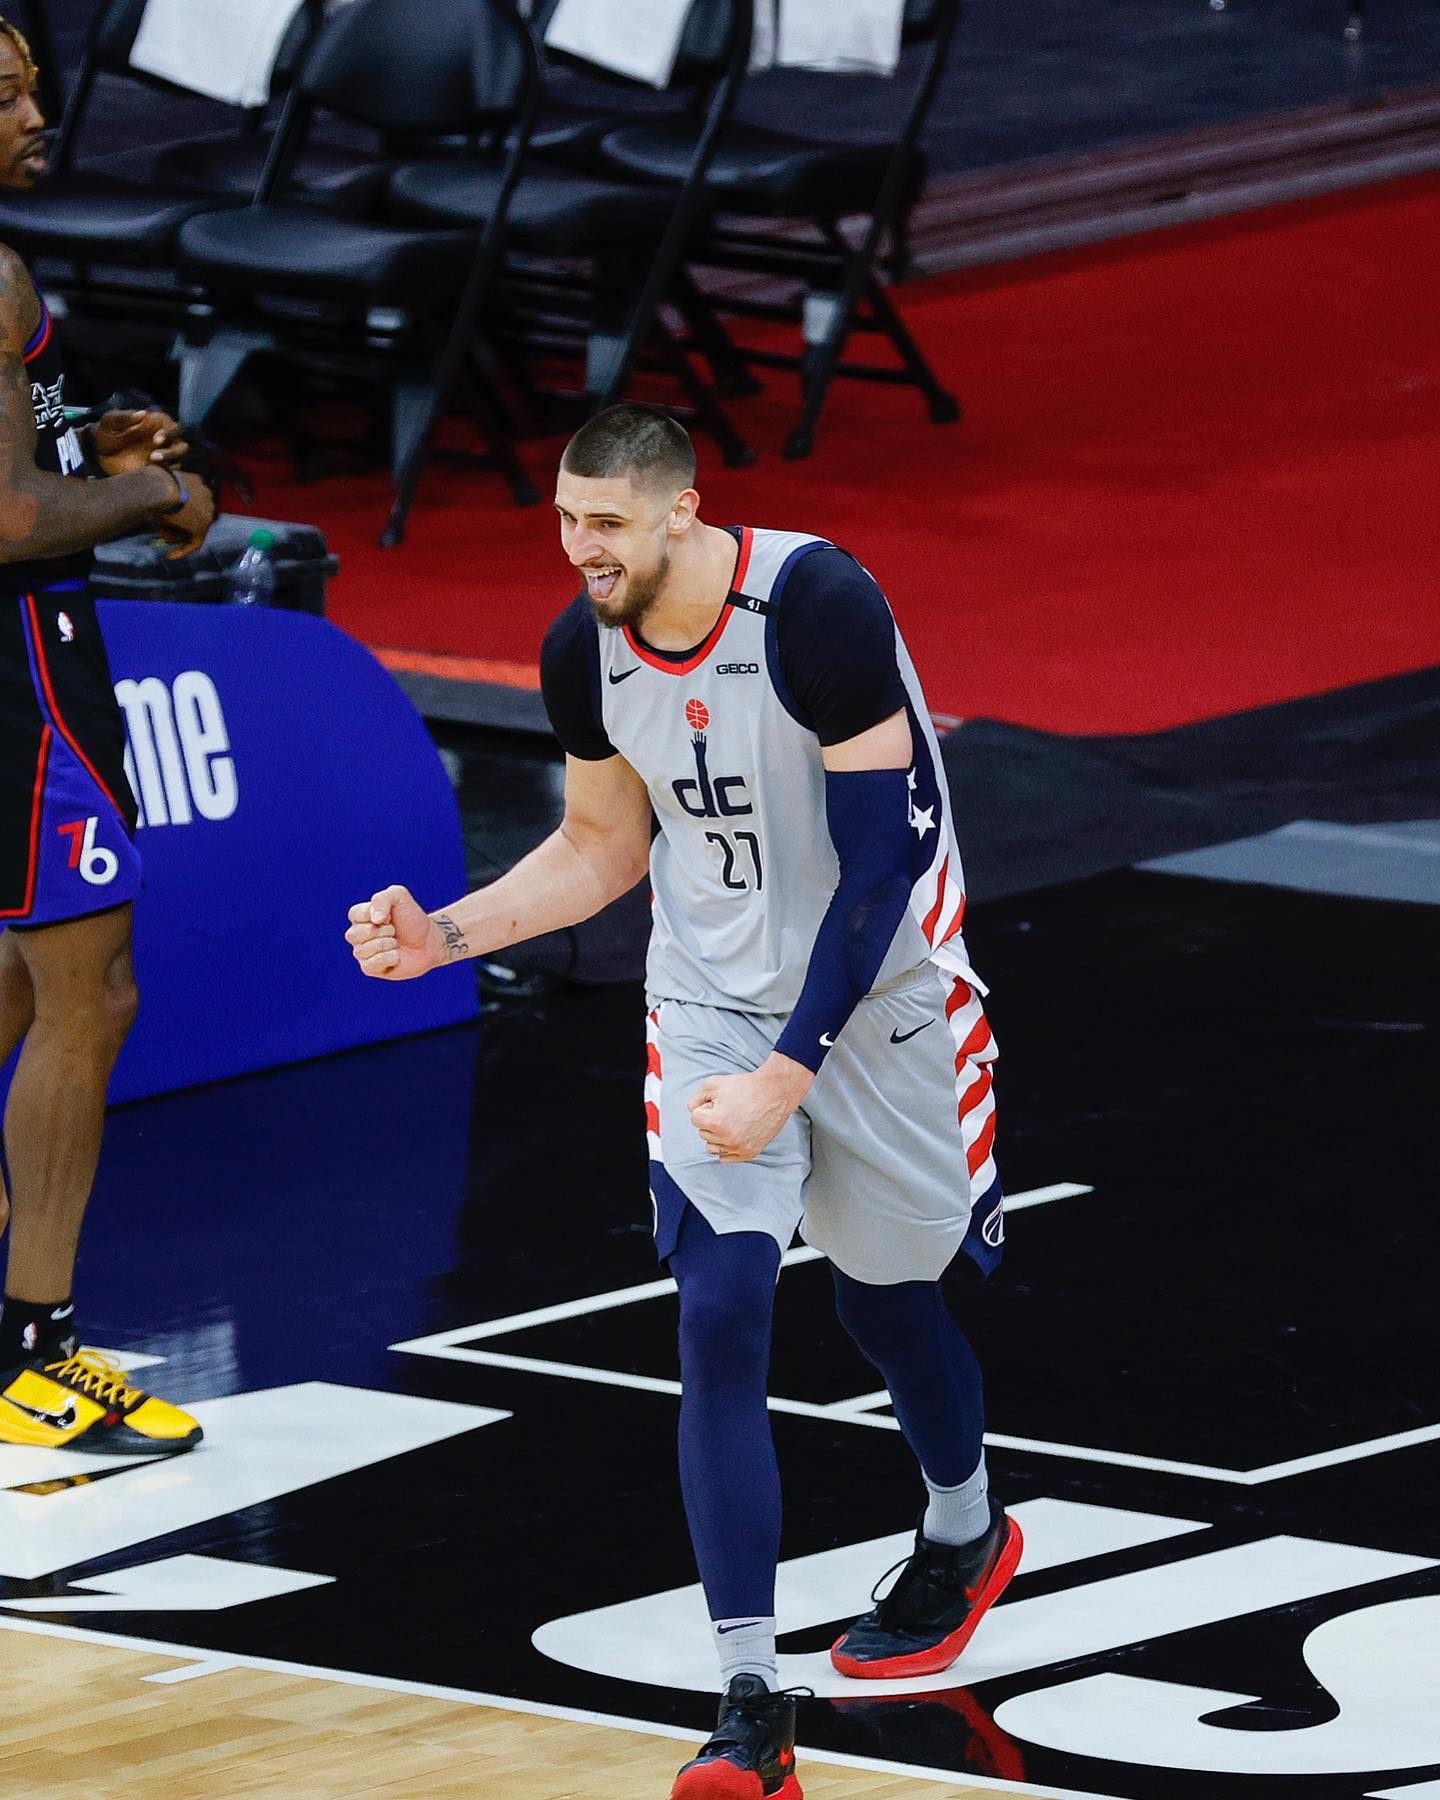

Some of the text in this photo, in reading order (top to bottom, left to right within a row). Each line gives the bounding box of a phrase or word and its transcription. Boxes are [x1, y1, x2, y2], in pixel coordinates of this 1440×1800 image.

[747, 599, 761, 611] 41
[57, 816, 119, 886] 76
[705, 831, 763, 892] 27
[531, 1497, 1440, 1799] US
